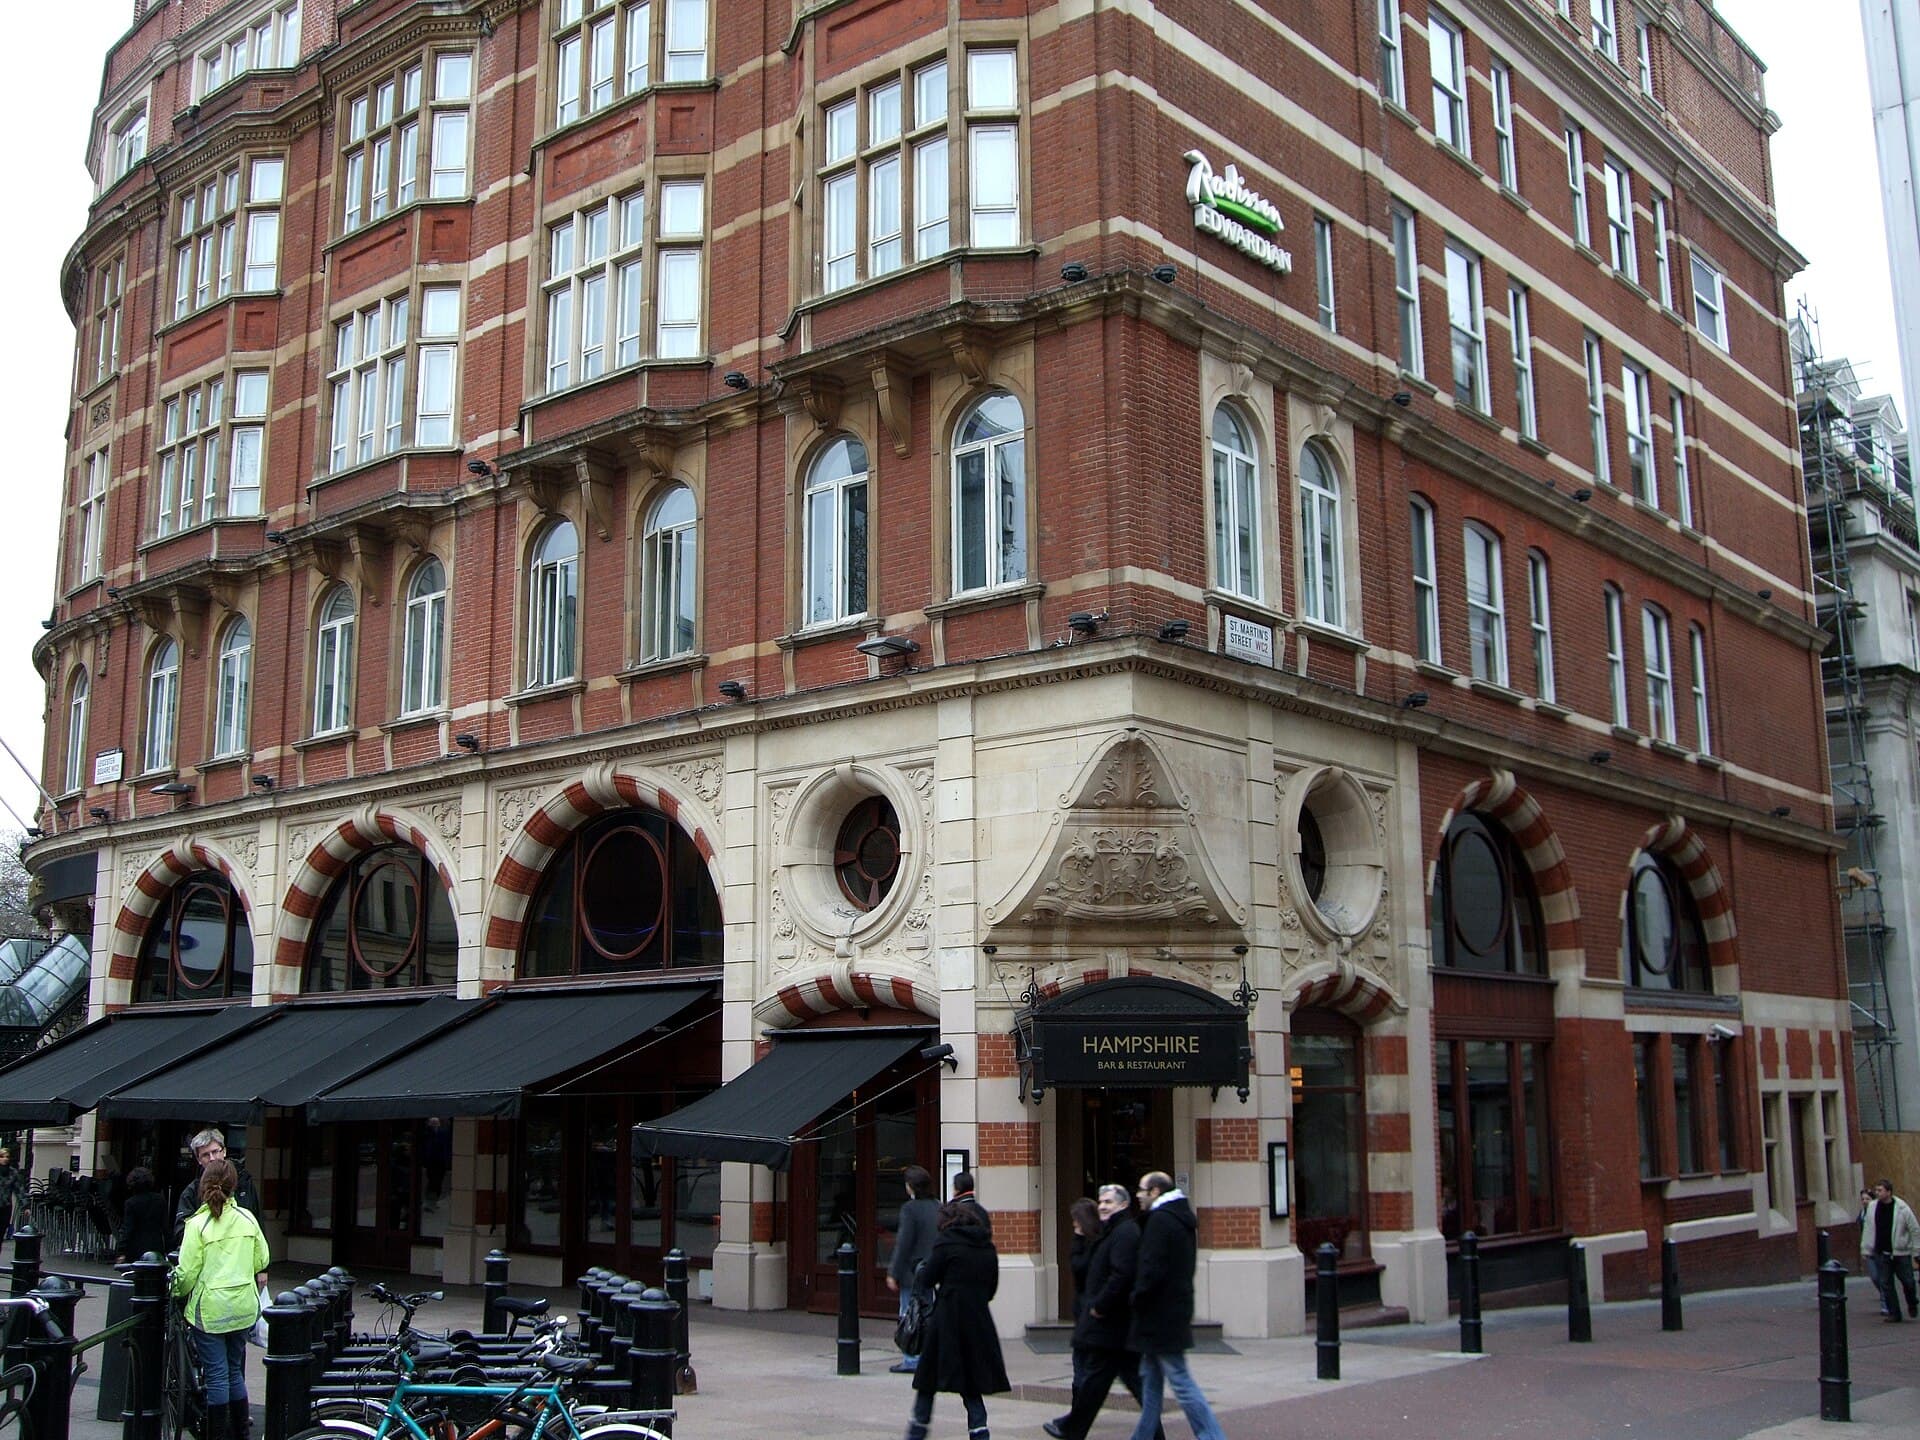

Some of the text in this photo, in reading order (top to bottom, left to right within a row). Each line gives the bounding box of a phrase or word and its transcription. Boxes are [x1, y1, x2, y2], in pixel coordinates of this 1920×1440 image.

[1183, 149, 1285, 231] Radisson
[1194, 203, 1292, 273] EDWARDIAN
[1230, 633, 1269, 654] STREET WC2
[1083, 1036, 1200, 1054] HAMPSHIRE
[1097, 1061, 1187, 1070] BAR & RESTAURANT
